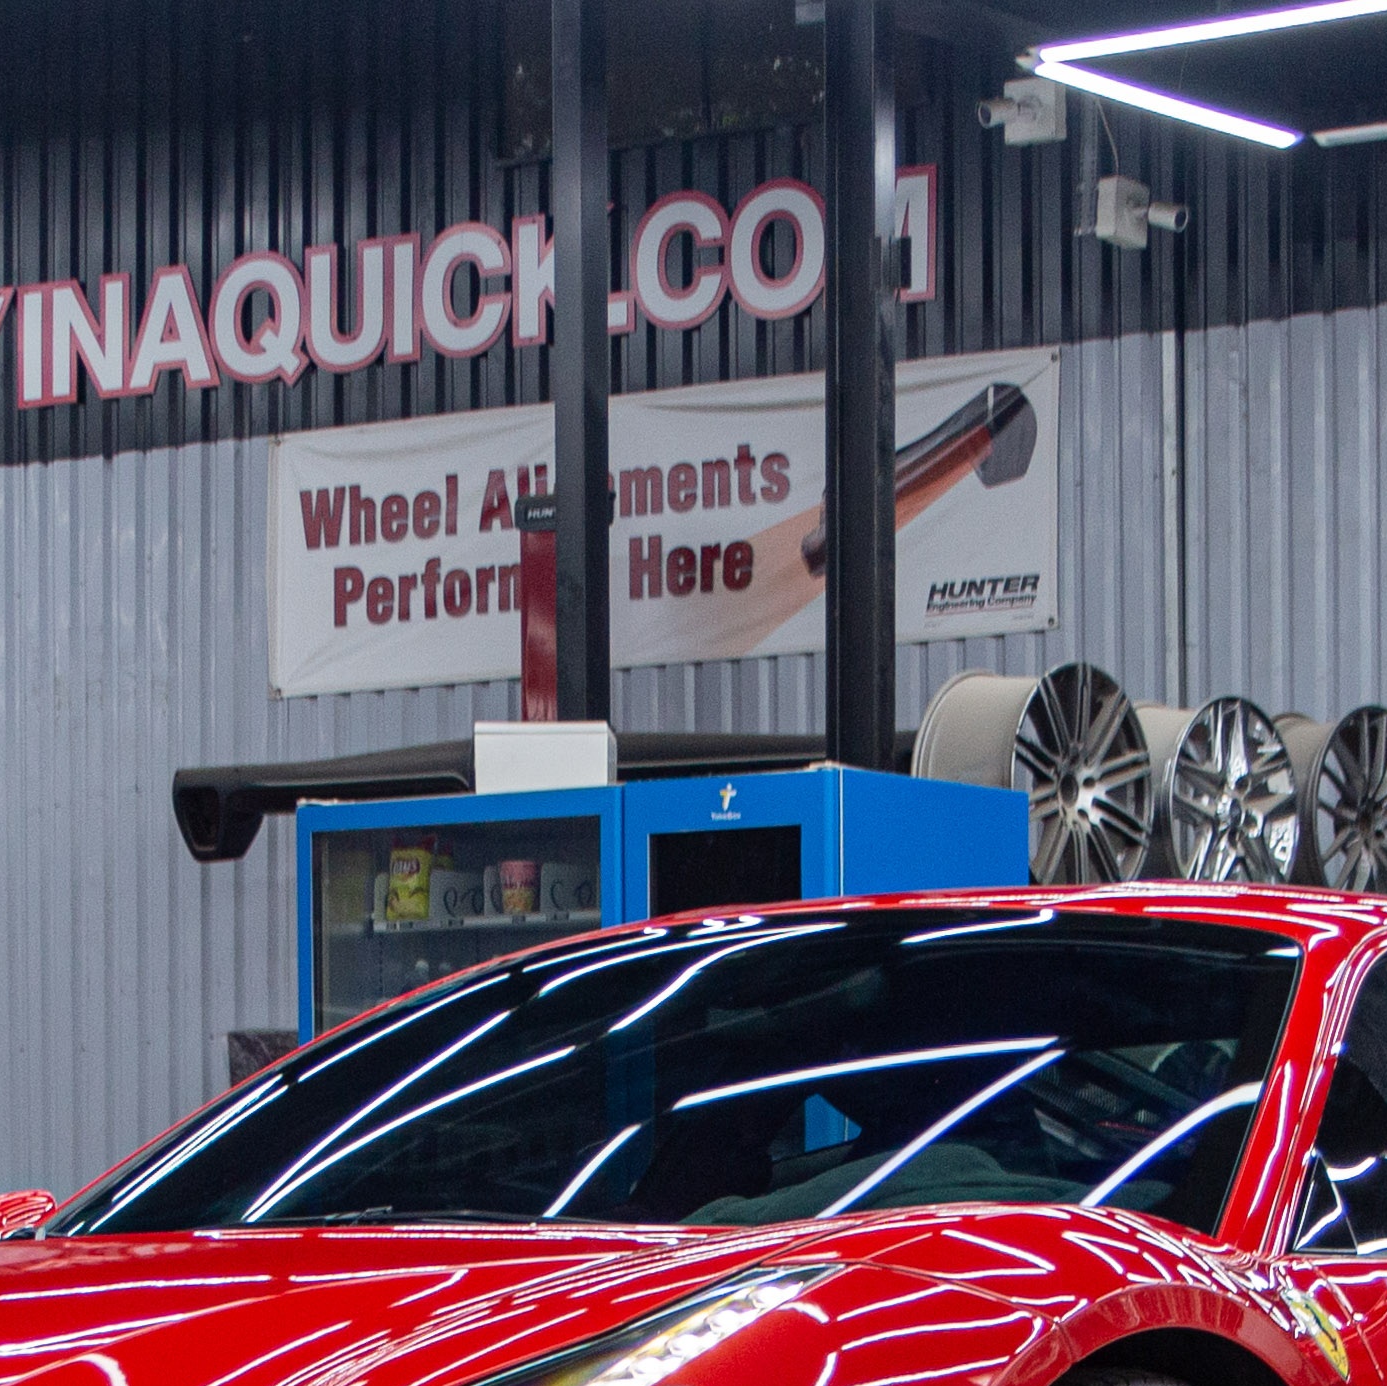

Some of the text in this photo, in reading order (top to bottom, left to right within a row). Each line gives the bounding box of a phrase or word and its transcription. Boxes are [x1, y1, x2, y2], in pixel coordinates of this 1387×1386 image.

[300, 474, 458, 550] Wheel
[628, 533, 754, 602] Here
[926, 574, 1040, 601] HUNTER
